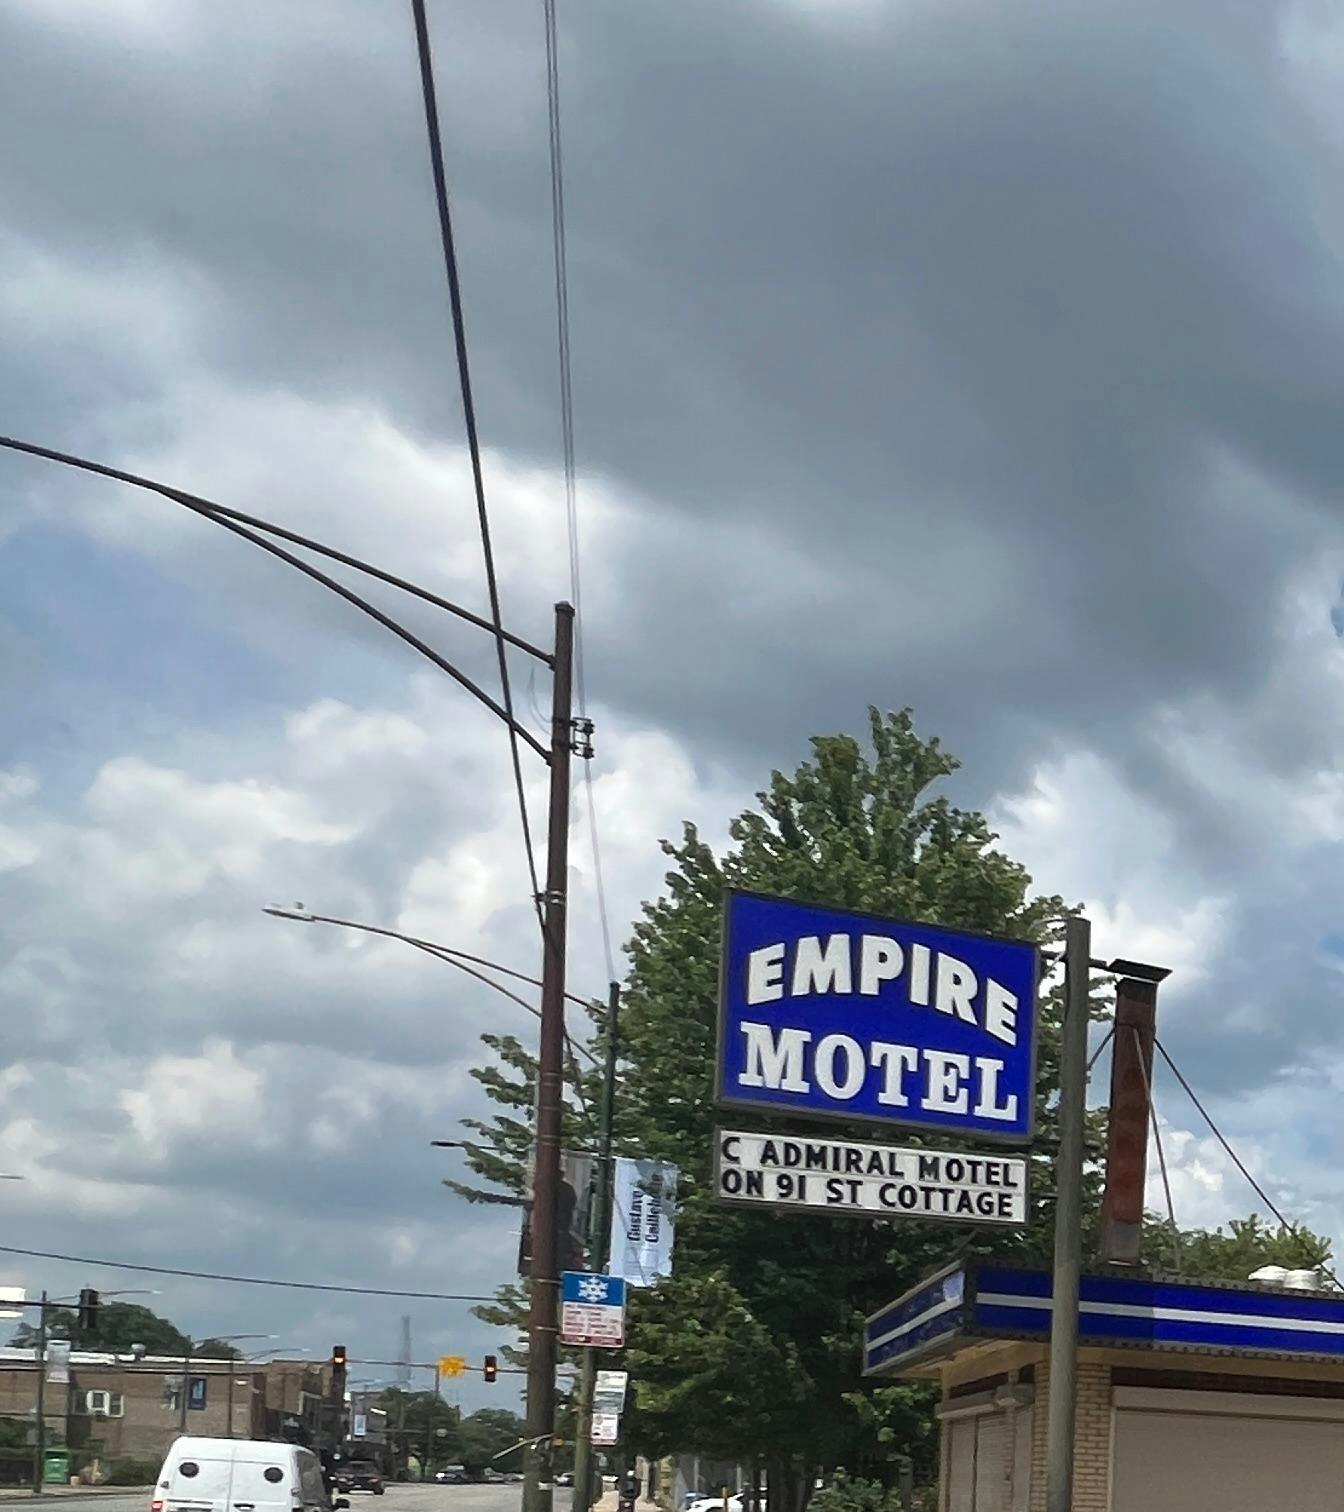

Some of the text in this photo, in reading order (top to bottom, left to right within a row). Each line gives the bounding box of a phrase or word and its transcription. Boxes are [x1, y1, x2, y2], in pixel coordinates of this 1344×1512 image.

[747, 934, 1019, 1047] EMPIRE
[738, 1021, 1019, 1122] MOTEL
[760, 1139, 905, 1177] ADMIRAL
[919, 1154, 1019, 1188] MOTEL
[627, 1190, 643, 1242] Gustave
[721, 1169, 1013, 1218] ON 91 ST COTTAGE
